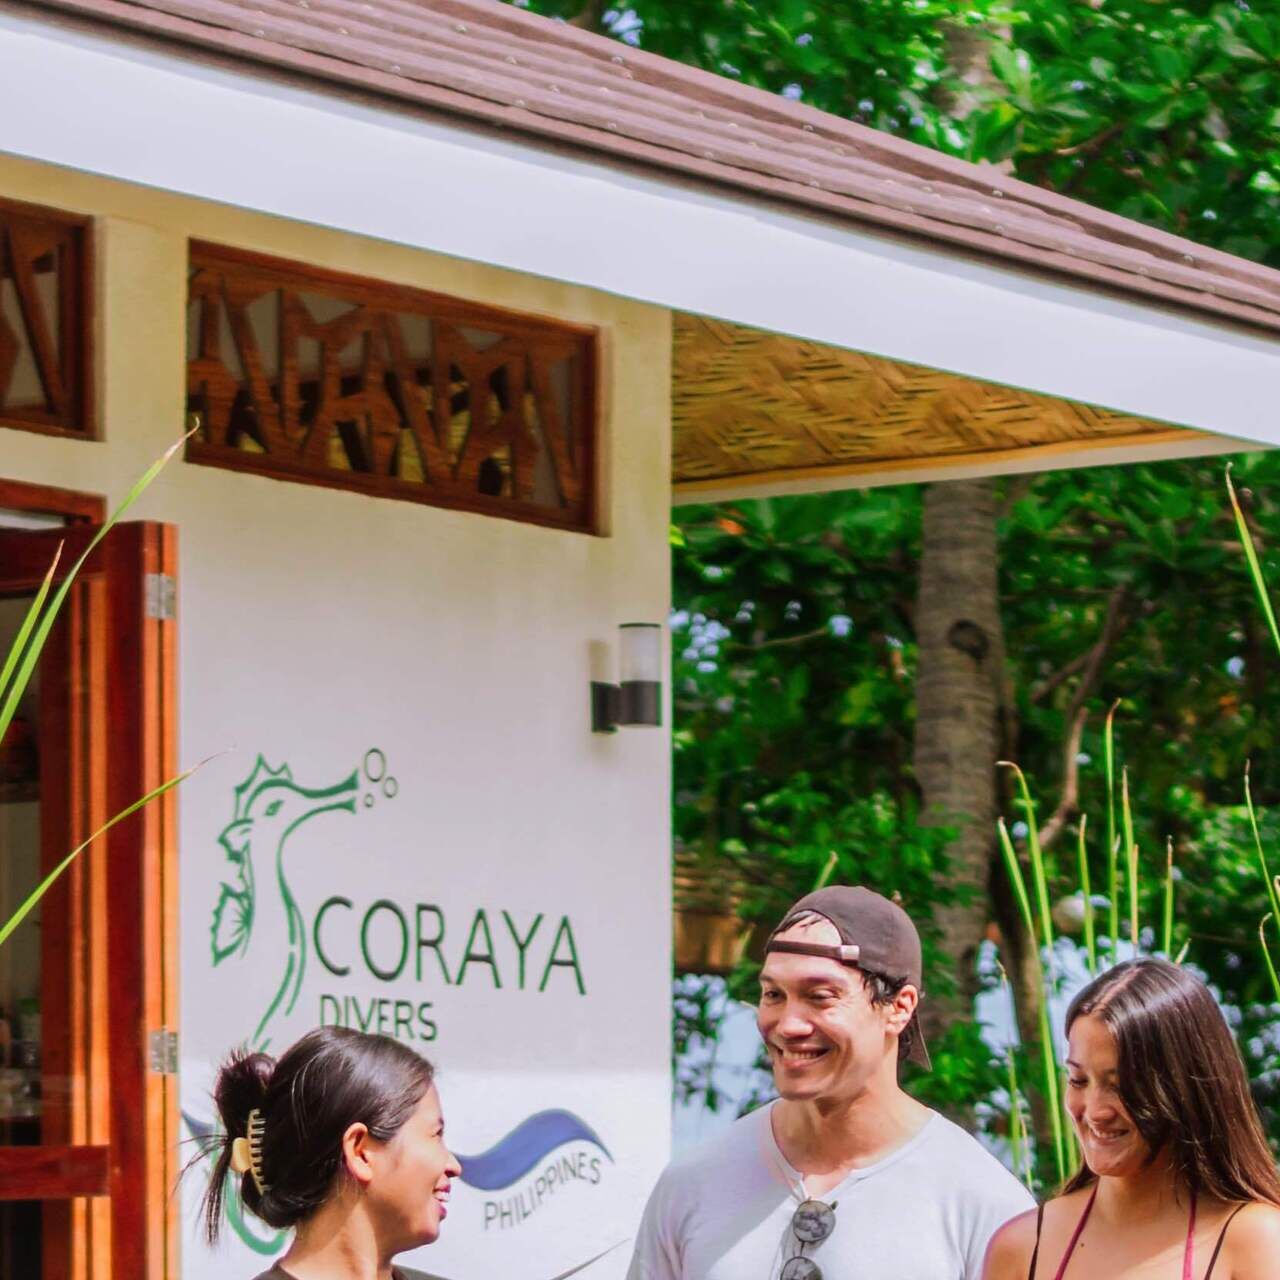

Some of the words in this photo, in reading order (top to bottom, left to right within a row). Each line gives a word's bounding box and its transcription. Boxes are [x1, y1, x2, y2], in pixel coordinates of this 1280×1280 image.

[313, 896, 587, 996] CORAYA
[320, 994, 437, 1041] DIVERS
[484, 1152, 601, 1231] PHILIPPINES
